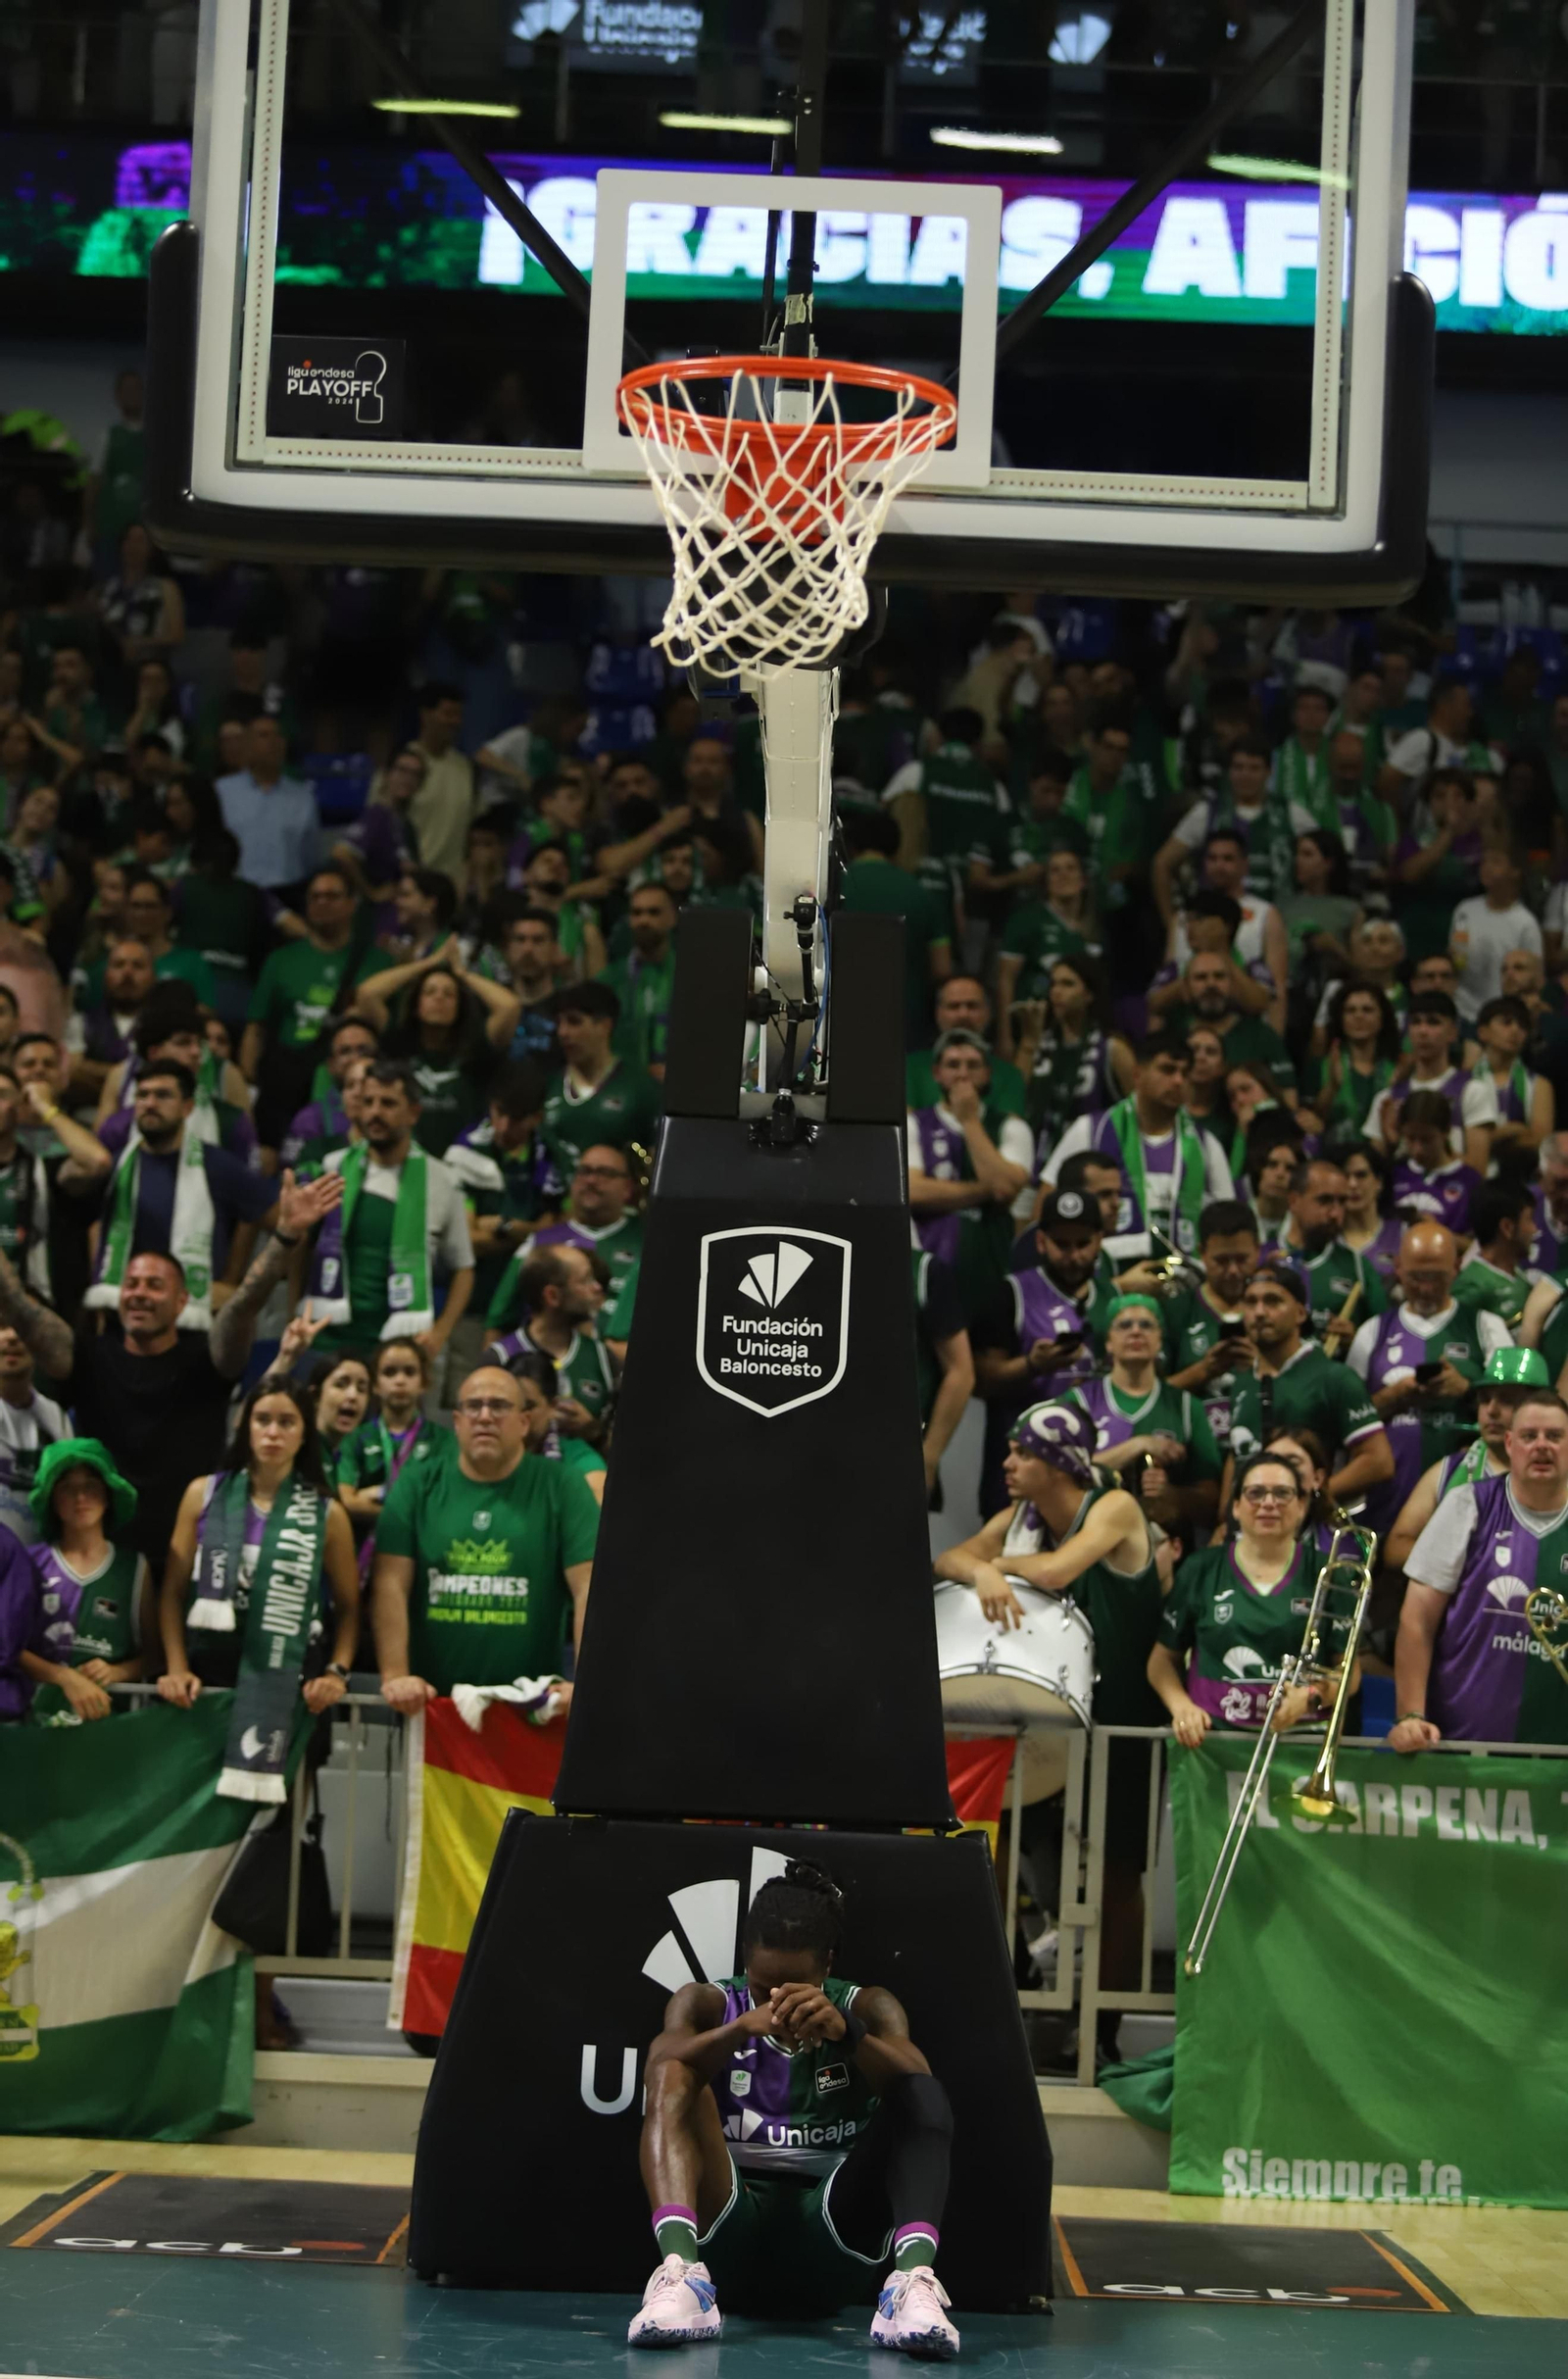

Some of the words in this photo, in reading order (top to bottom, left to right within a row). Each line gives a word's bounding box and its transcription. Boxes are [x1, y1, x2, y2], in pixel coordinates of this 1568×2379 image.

[1142, 192, 1568, 311] AFCIÓ
[310, 368, 355, 378] endesa
[287, 378, 372, 397] PLAYOFF
[722, 1314, 823, 1337] Fundación
[737, 1338, 808, 1363] Unicaja
[720, 1358, 822, 1377] Baloncesto
[261, 1528, 318, 1636] UNICAJA
[767, 2118, 857, 2147] Unicaja
[1418, 2159, 1463, 2197] te
[54, 2237, 303, 2255] acb
[1103, 2283, 1350, 2302] acb
